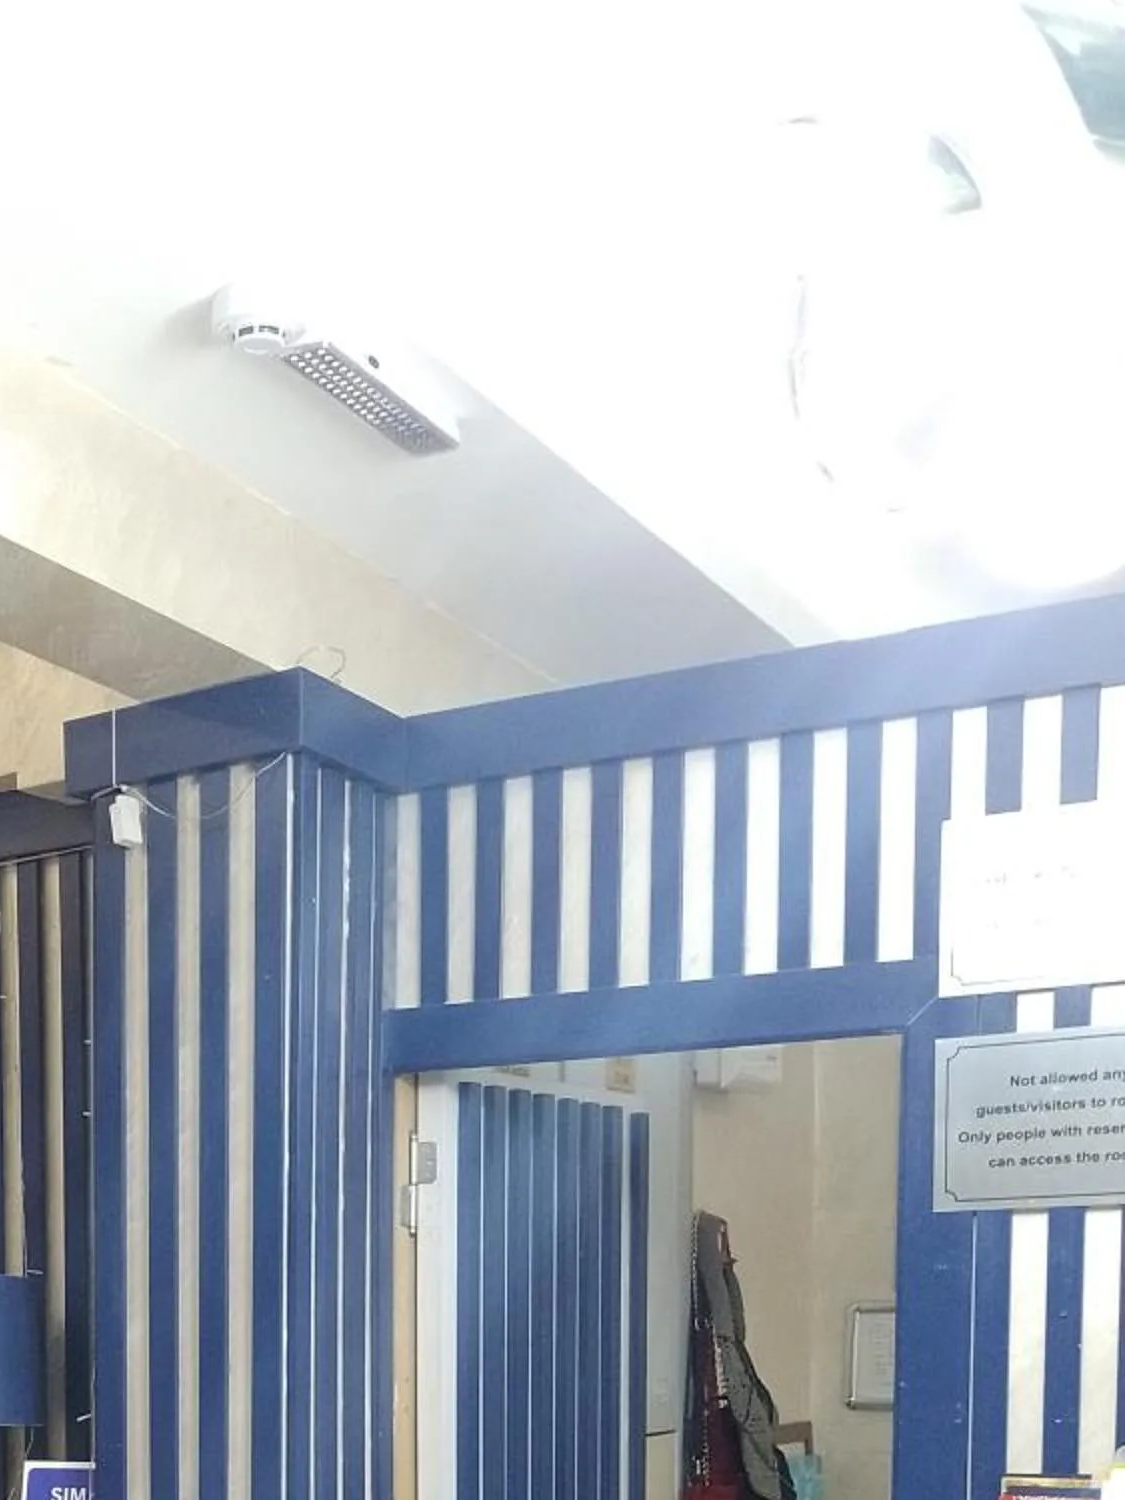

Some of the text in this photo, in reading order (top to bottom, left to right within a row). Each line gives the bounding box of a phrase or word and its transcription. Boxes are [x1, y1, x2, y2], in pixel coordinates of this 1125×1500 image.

[1010, 1075, 1036, 1087] Not
[1040, 1068, 1097, 1085] allowed
[975, 1097, 1086, 1118] guests/visitors
[1090, 1097, 1106, 1108] to
[958, 1131, 992, 1144] Only
[996, 1126, 1046, 1143] people
[1050, 1124, 1082, 1137] with
[988, 1156, 1015, 1168] can
[1019, 1153, 1071, 1166] access
[1076, 1151, 1100, 1164] the
